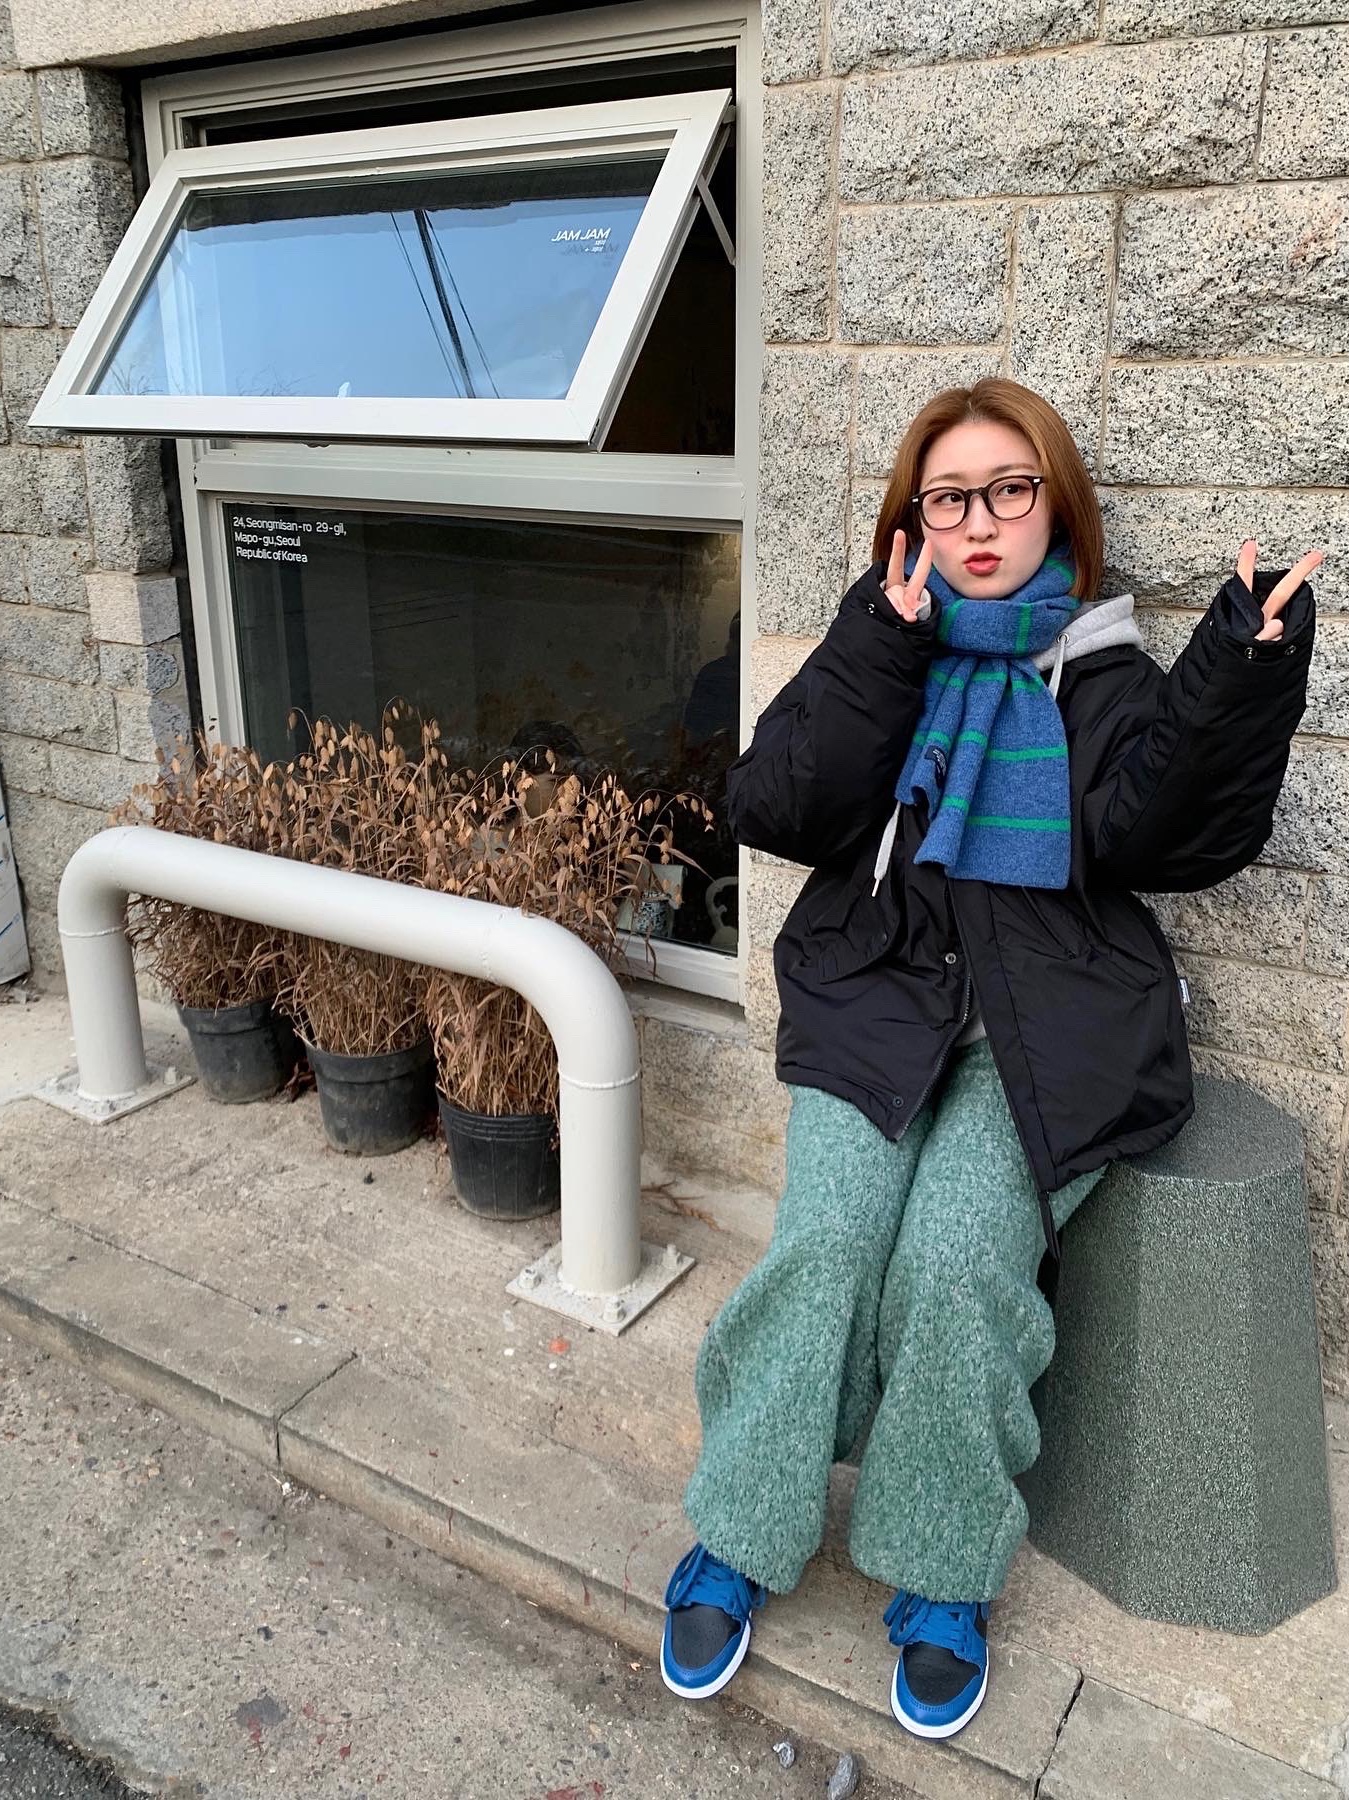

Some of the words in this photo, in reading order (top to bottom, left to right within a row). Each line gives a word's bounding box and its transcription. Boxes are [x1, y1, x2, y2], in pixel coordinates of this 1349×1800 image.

[551, 230, 581, 241] JAM
[580, 227, 611, 239] JAM
[236, 546, 272, 560] Republic
[281, 550, 308, 563] Korea
